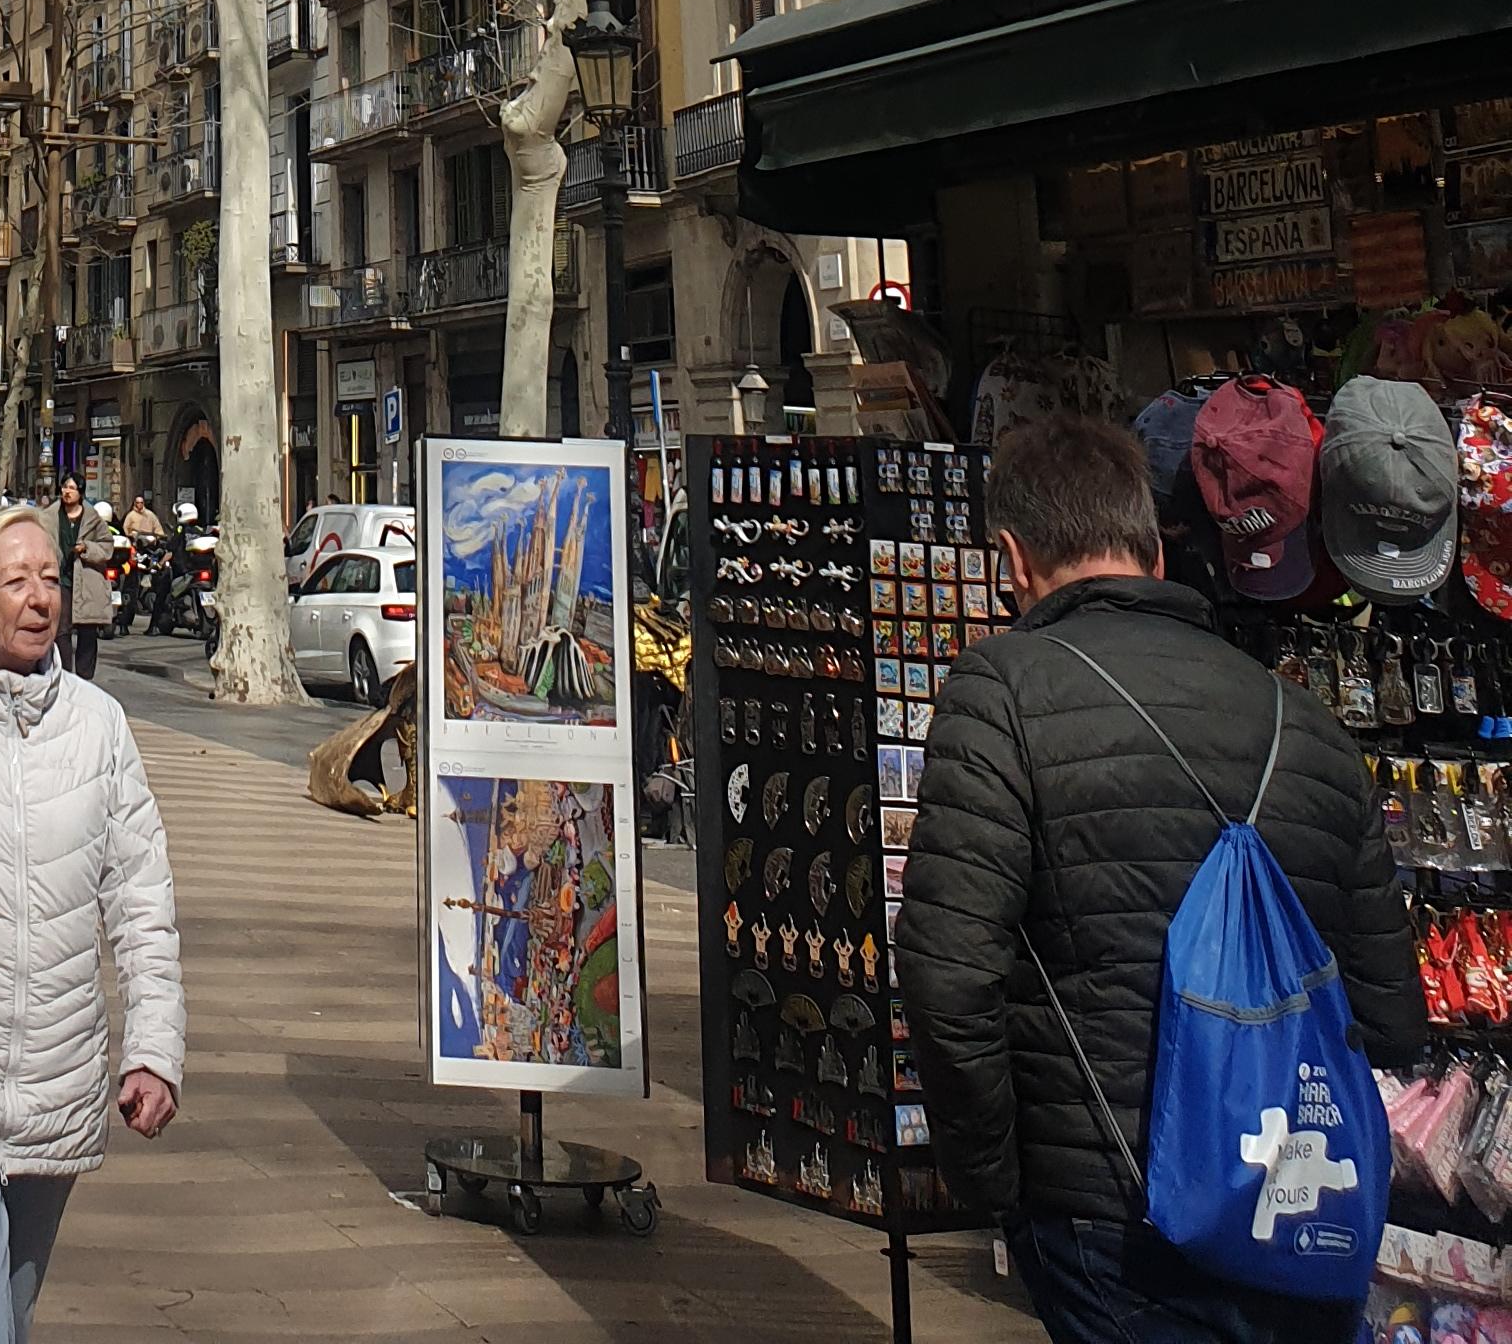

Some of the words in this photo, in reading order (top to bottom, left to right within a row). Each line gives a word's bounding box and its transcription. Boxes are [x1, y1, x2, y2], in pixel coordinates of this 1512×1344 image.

[1214, 165, 1320, 208] BARCELONA
[1224, 217, 1304, 256] ESPAÑA
[387, 396, 397, 431] P
[1392, 563, 1446, 588] BARCELONA
[443, 722, 618, 741] BARCELONA
[1266, 1186, 1309, 1210] yours
